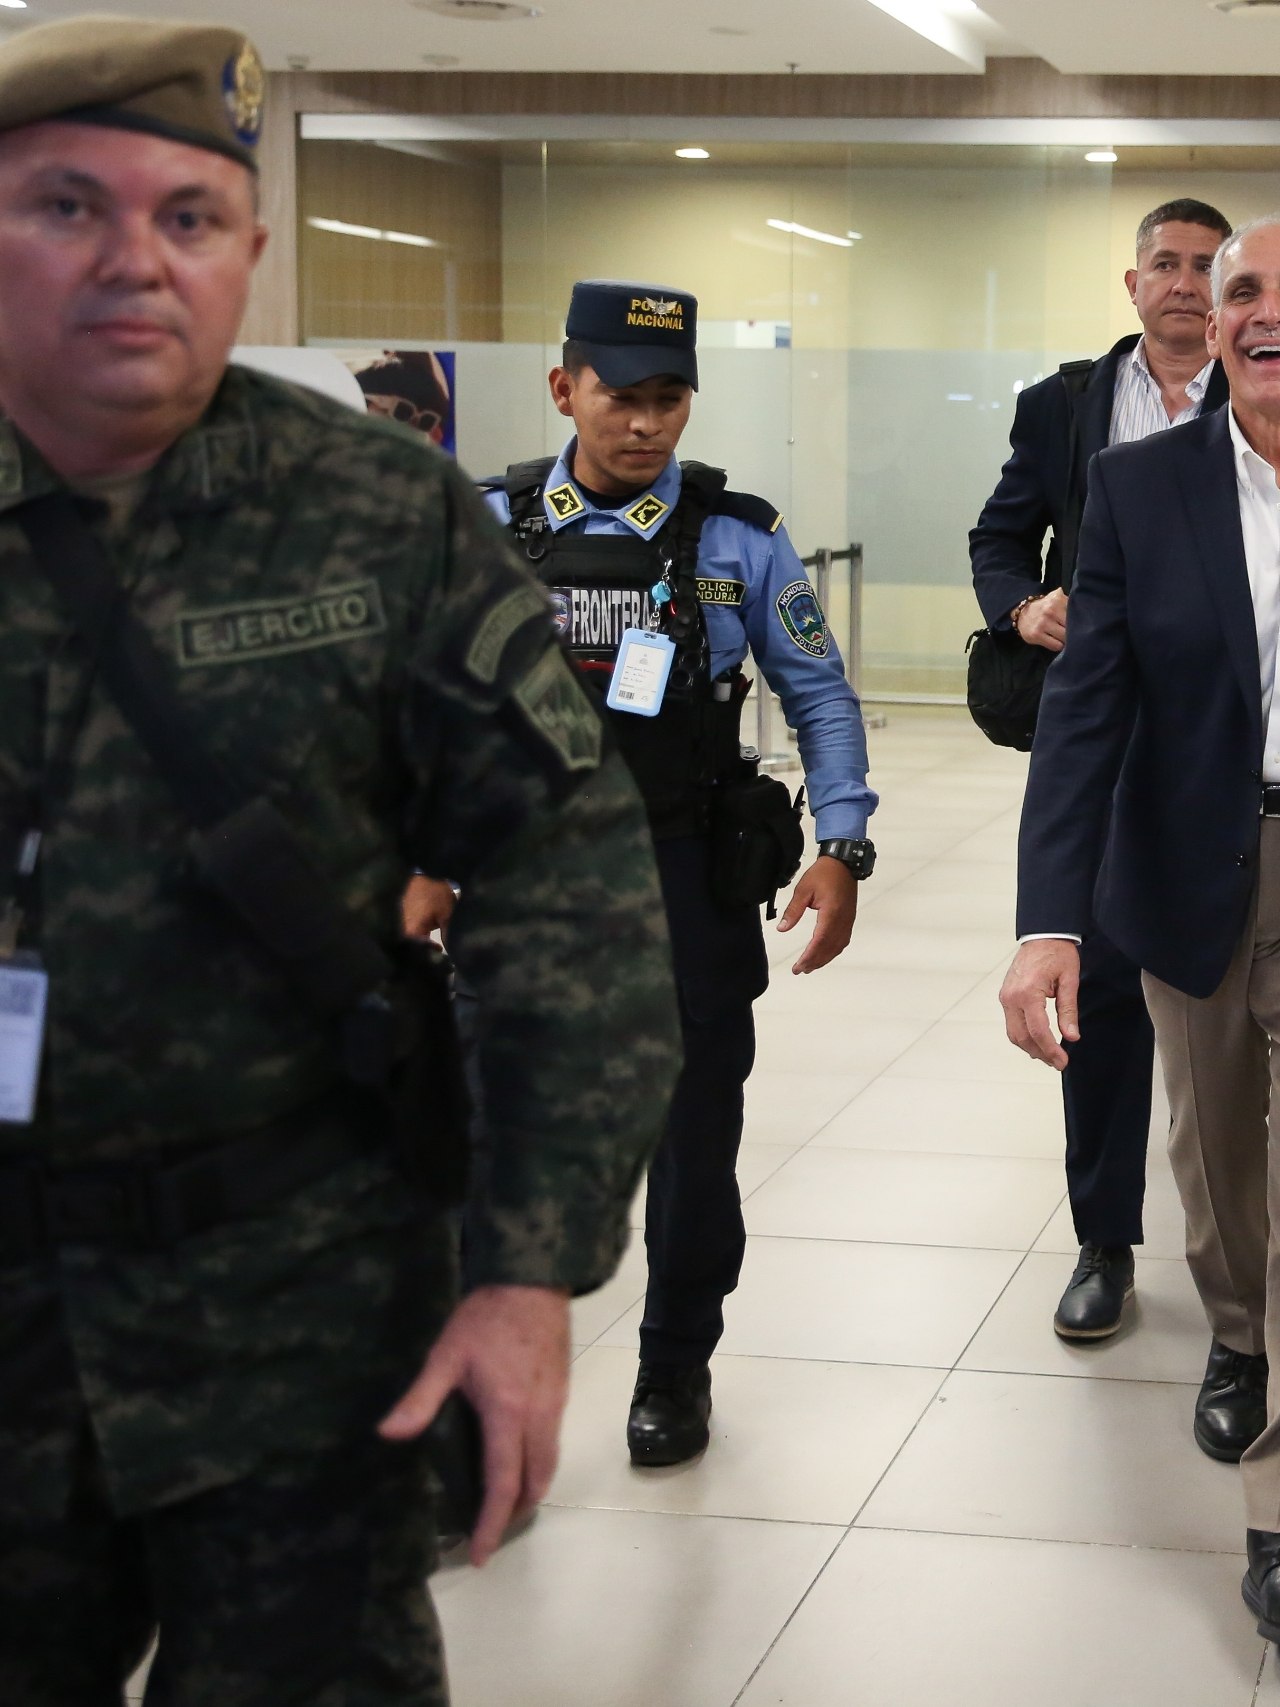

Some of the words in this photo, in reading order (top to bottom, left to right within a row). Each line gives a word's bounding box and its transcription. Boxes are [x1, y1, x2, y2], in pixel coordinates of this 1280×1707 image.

[631, 299, 683, 315] POIA
[627, 312, 684, 330] NACIONAL
[698, 581, 734, 592] OLICIA
[696, 590, 737, 602] NDURAS
[191, 593, 369, 654] EJERCITO
